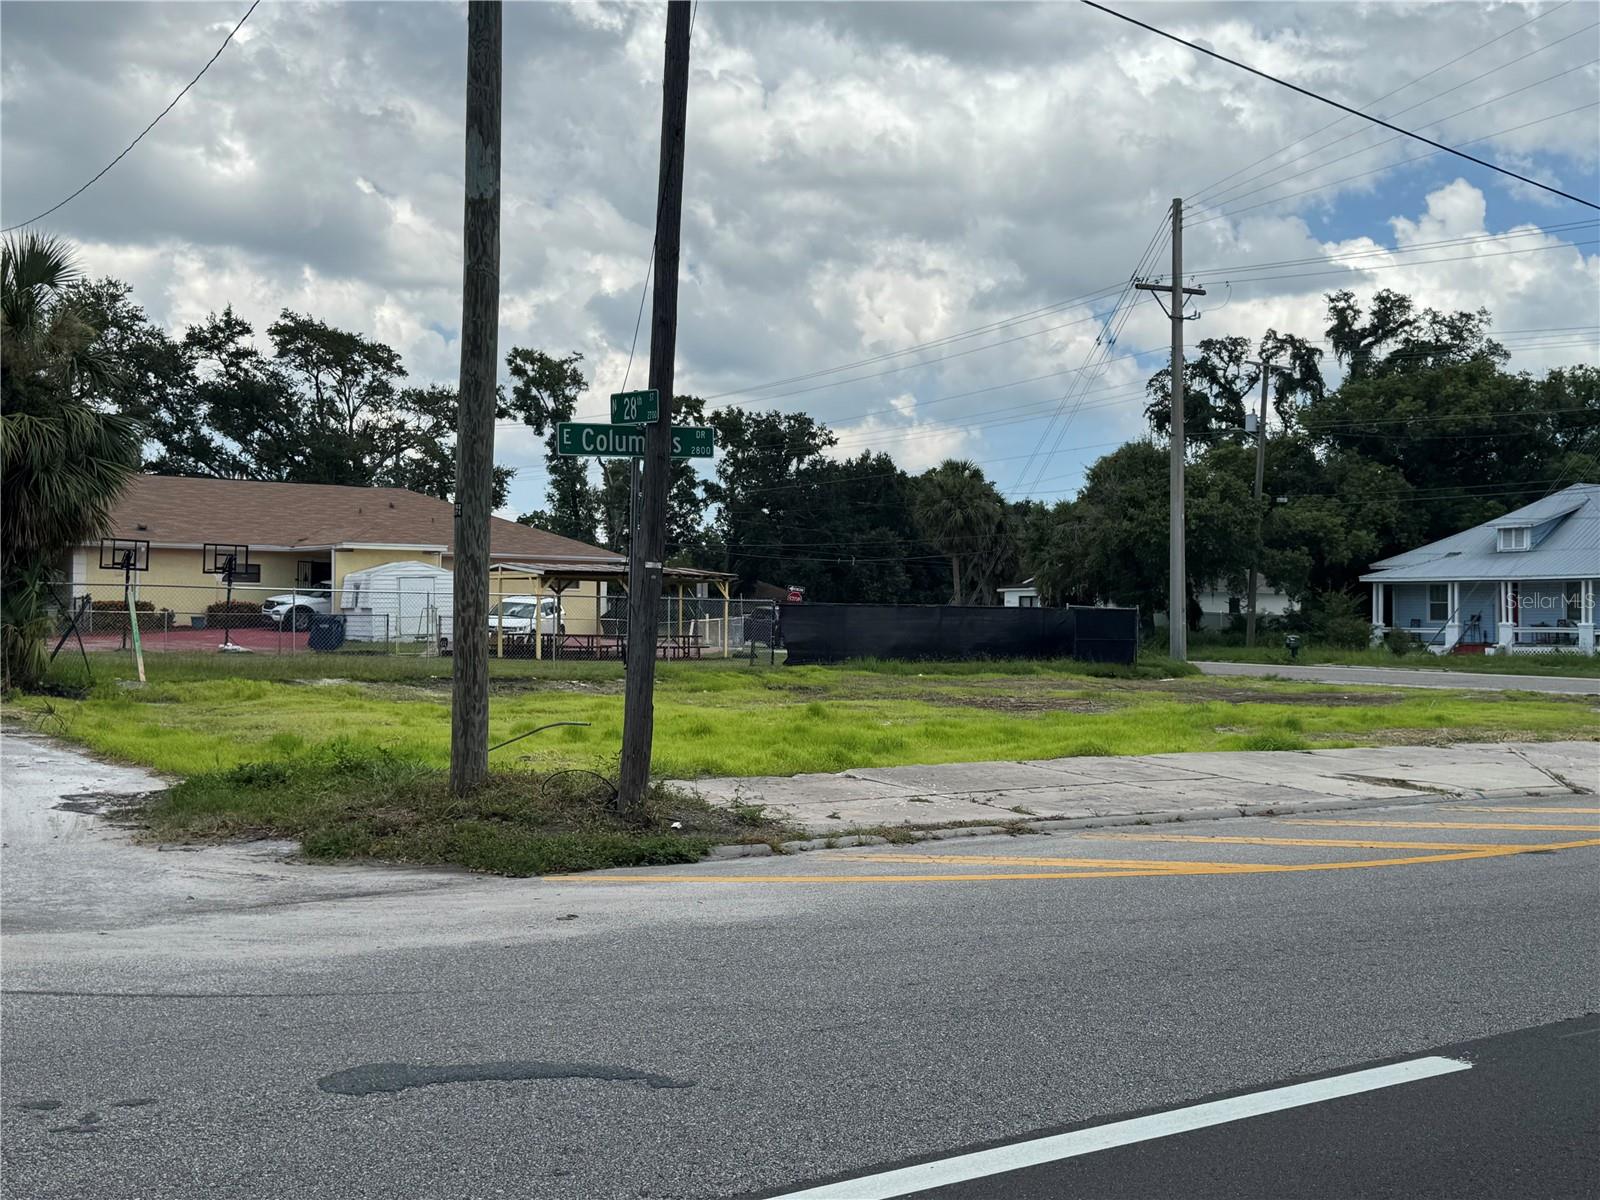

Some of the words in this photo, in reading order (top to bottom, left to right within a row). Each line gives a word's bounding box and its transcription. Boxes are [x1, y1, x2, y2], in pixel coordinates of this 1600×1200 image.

[612, 399, 617, 415] N
[563, 429, 572, 444] E
[582, 428, 682, 452] Colums
[695, 430, 706, 439] DR
[691, 446, 711, 455] 2800
